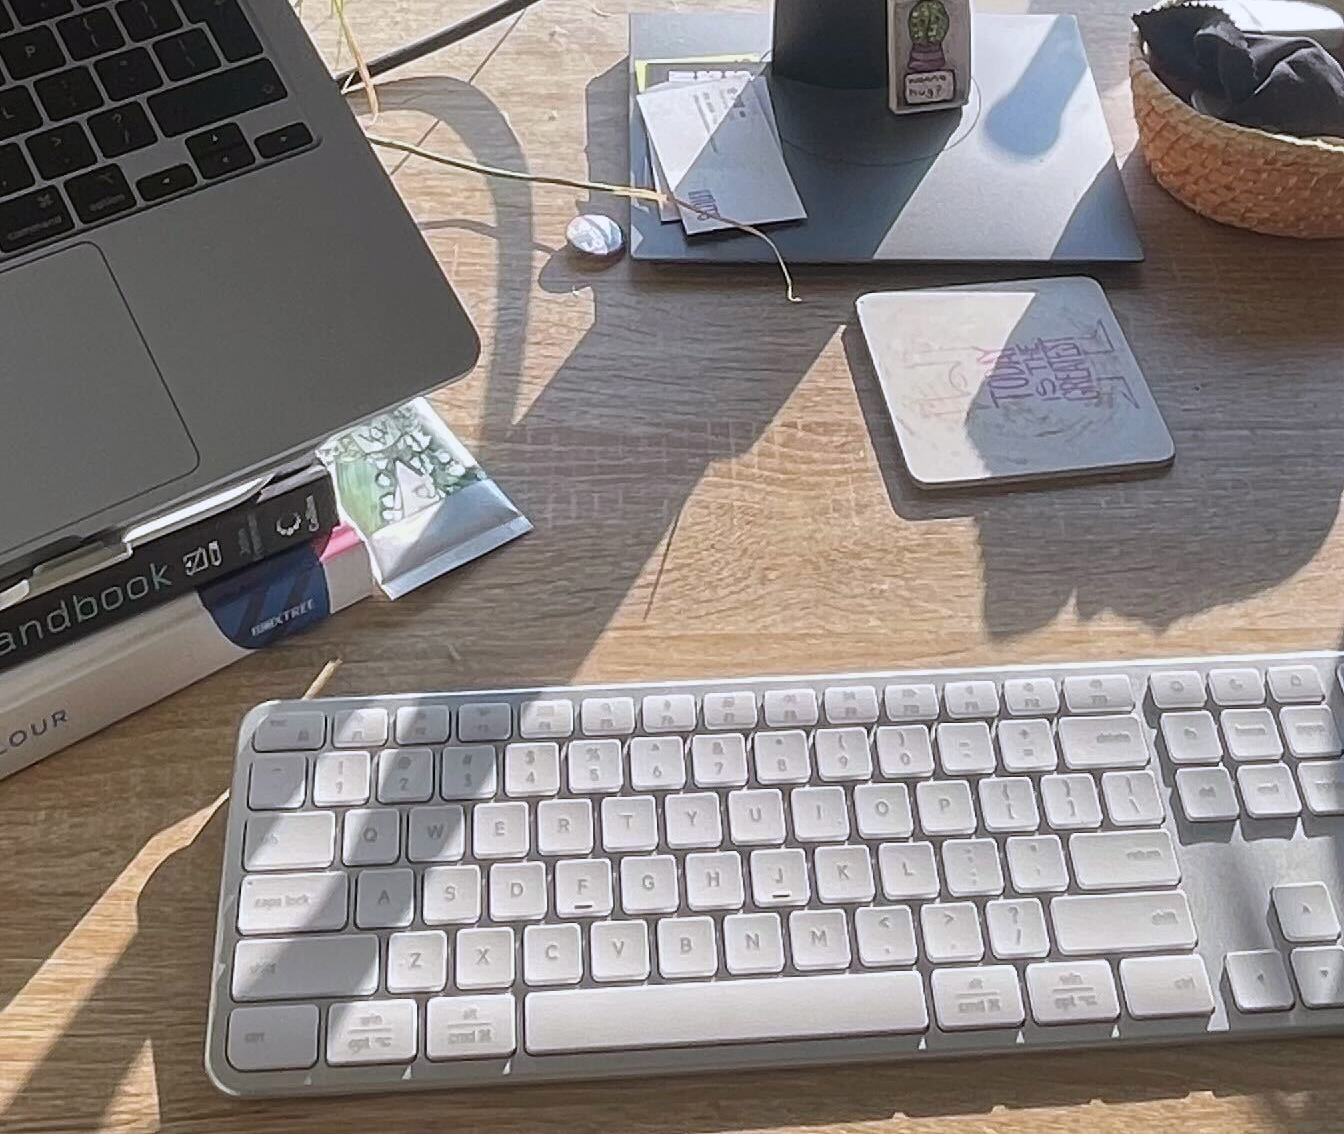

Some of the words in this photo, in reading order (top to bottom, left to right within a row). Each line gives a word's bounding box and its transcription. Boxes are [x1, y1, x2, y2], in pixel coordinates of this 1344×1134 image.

[25, 46, 35, 57] P
[909, 85, 942, 99] hug?
[1, 107, 14, 119] L
[1016, 344, 1048, 376] THE
[974, 346, 1033, 408] TODAY
[1036, 378, 1063, 401] IS
[900, 753, 911, 766] 0
[589, 769, 599, 781] 5
[653, 766, 662, 778] 6
[715, 762, 723, 775] 7
[400, 778, 409, 791] 2
[526, 772, 535, 784] 4
[875, 801, 889, 817] O
[939, 799, 950, 812] P
[618, 815, 633, 829] T
[685, 811, 697, 826] Y
[749, 808, 762, 823] U
[427, 824, 444, 839] W
[495, 821, 504, 836] E
[558, 818, 569, 833] R
[363, 826, 378, 842] Q
[775, 868, 783, 884] J
[837, 865, 849, 880] K
[902, 862, 913, 876] L
[578, 879, 587, 894] F
[642, 875, 654, 891] G
[706, 872, 720, 887] H
[378, 890, 390, 905] A
[444, 886, 455, 902] S
[511, 883, 523, 898] D
[745, 933, 759, 949] N
[810, 930, 827, 946] M
[545, 945, 558, 961] C
[612, 941, 624, 957] V
[680, 938, 692, 954] B
[409, 953, 421, 970] Z
[477, 949, 489, 965] X
